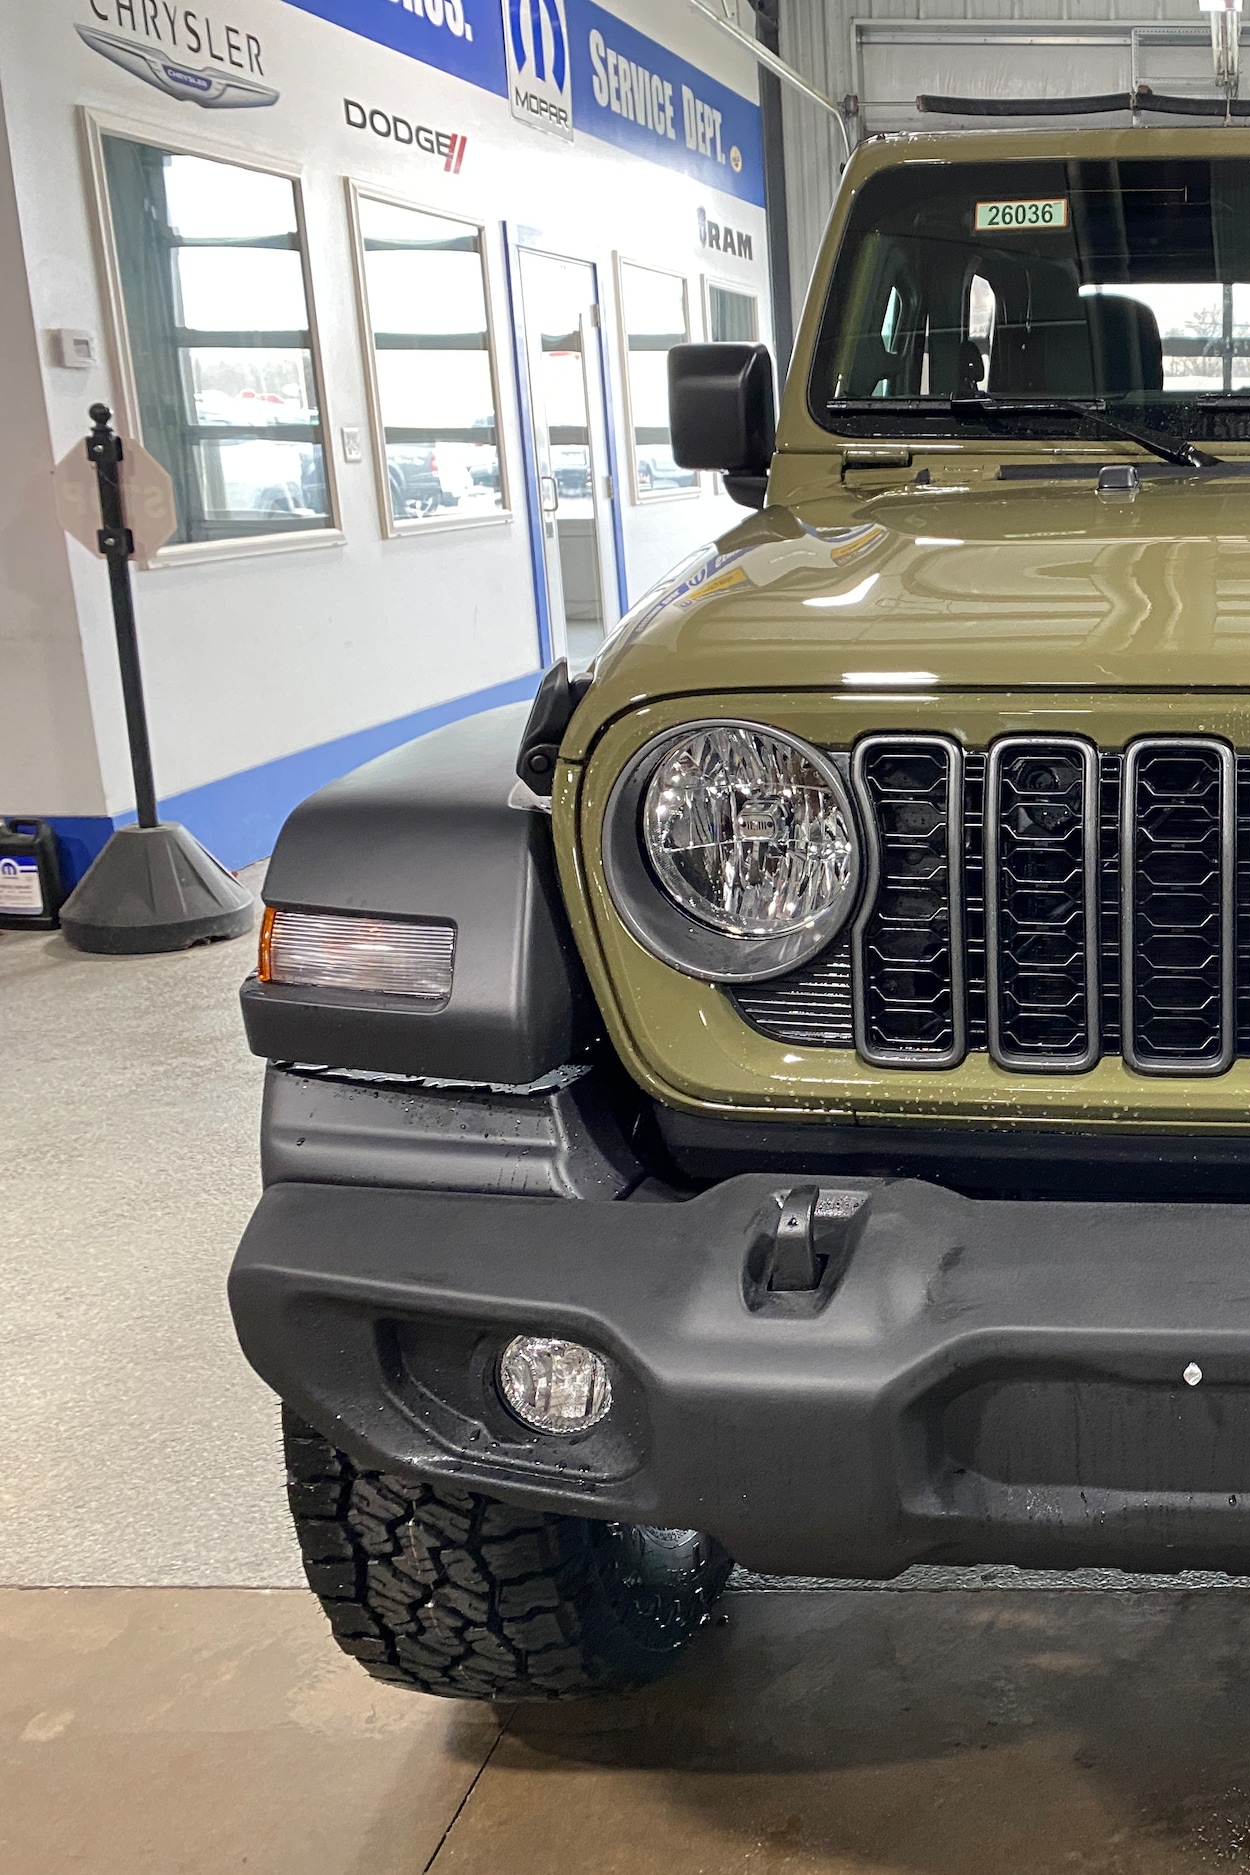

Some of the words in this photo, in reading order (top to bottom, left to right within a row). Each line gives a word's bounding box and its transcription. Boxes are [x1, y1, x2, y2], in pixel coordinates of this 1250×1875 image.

[515, 86, 570, 129] MOPAR
[589, 28, 676, 140] SERVICE
[681, 84, 726, 165] DEPT.
[343, 97, 454, 159] DODGE
[987, 202, 1054, 226] 26036
[706, 219, 754, 262] RAM
